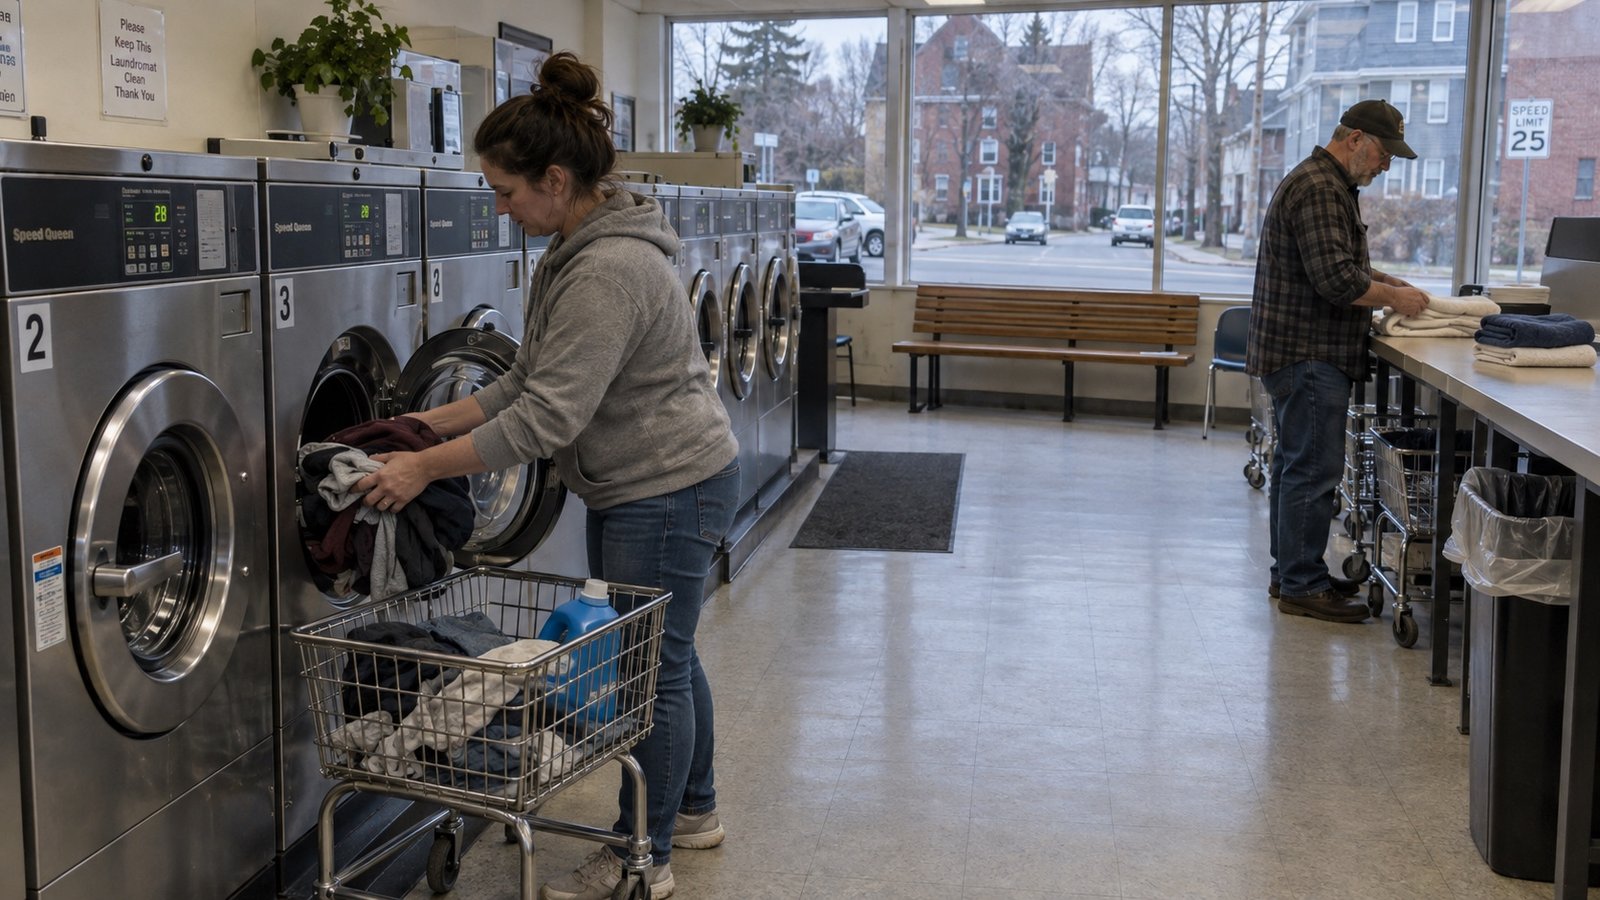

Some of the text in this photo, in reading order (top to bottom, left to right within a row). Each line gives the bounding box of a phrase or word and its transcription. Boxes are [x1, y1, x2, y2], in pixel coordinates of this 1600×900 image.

[120, 18, 145, 34] Please
[114, 36, 152, 53] Keep This
[110, 54, 157, 72] Laundromat
[124, 72, 145, 85] Clean
[114, 86, 155, 101] Thank You
[1512, 105, 1549, 115] SPEED
[1515, 118, 1543, 127] LIMIT
[1511, 130, 1545, 151] 25
[154, 205, 167, 222] 28
[13, 228, 74, 243] Speed Queen
[279, 285, 291, 321] 3
[25, 313, 46, 362] 2
